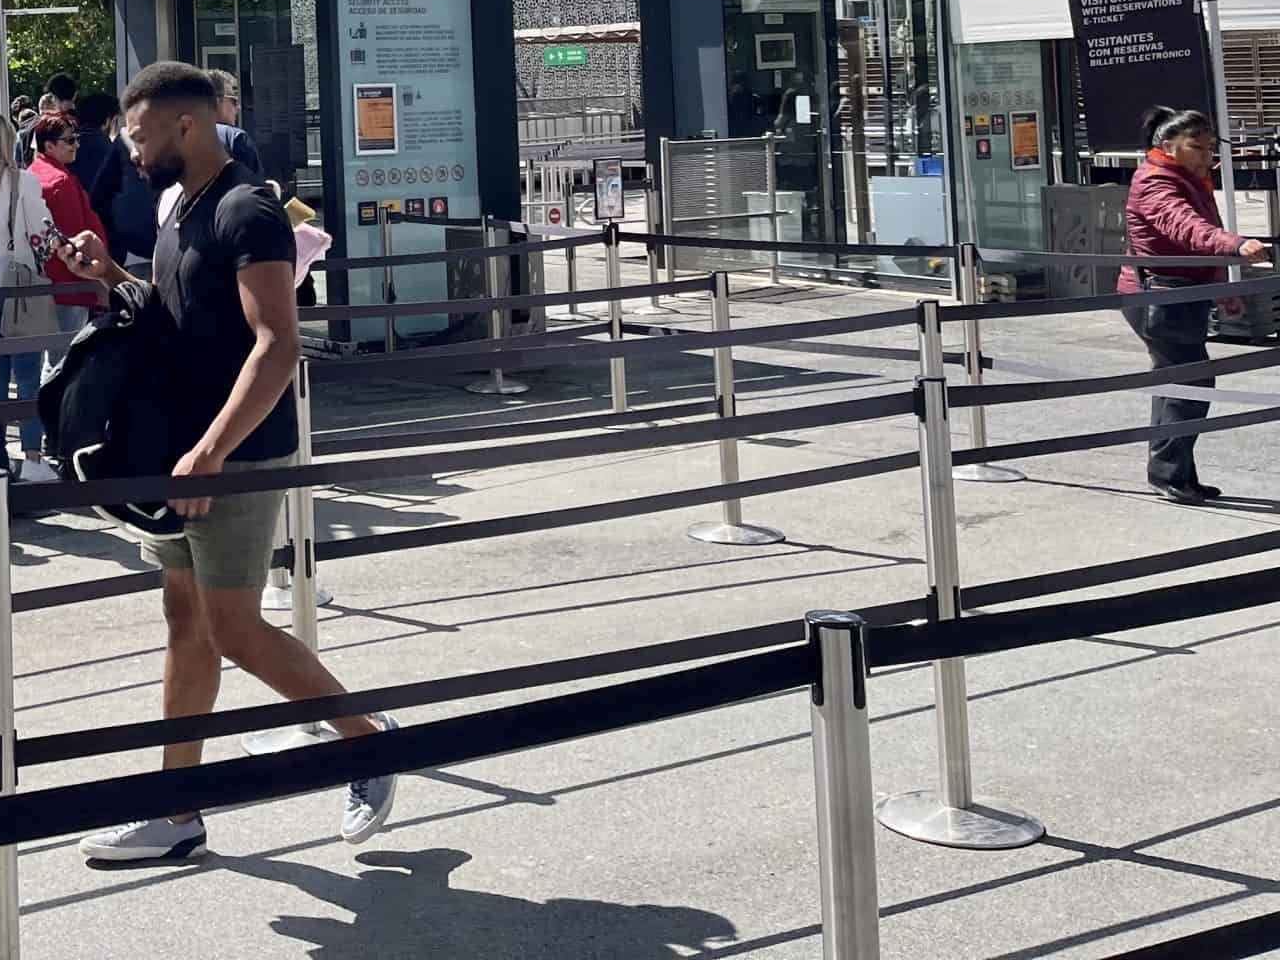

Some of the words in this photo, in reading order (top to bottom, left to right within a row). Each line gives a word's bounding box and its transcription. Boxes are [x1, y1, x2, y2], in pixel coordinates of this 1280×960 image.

[1082, 7, 1107, 17] WITH
[1083, 14, 1124, 25] E-TICKET
[1087, 32, 1154, 48] VISITANTES
[1089, 47, 1111, 58] CON
[1113, 42, 1164, 55] RESERVAS
[1090, 56, 1126, 67] BILLETE
